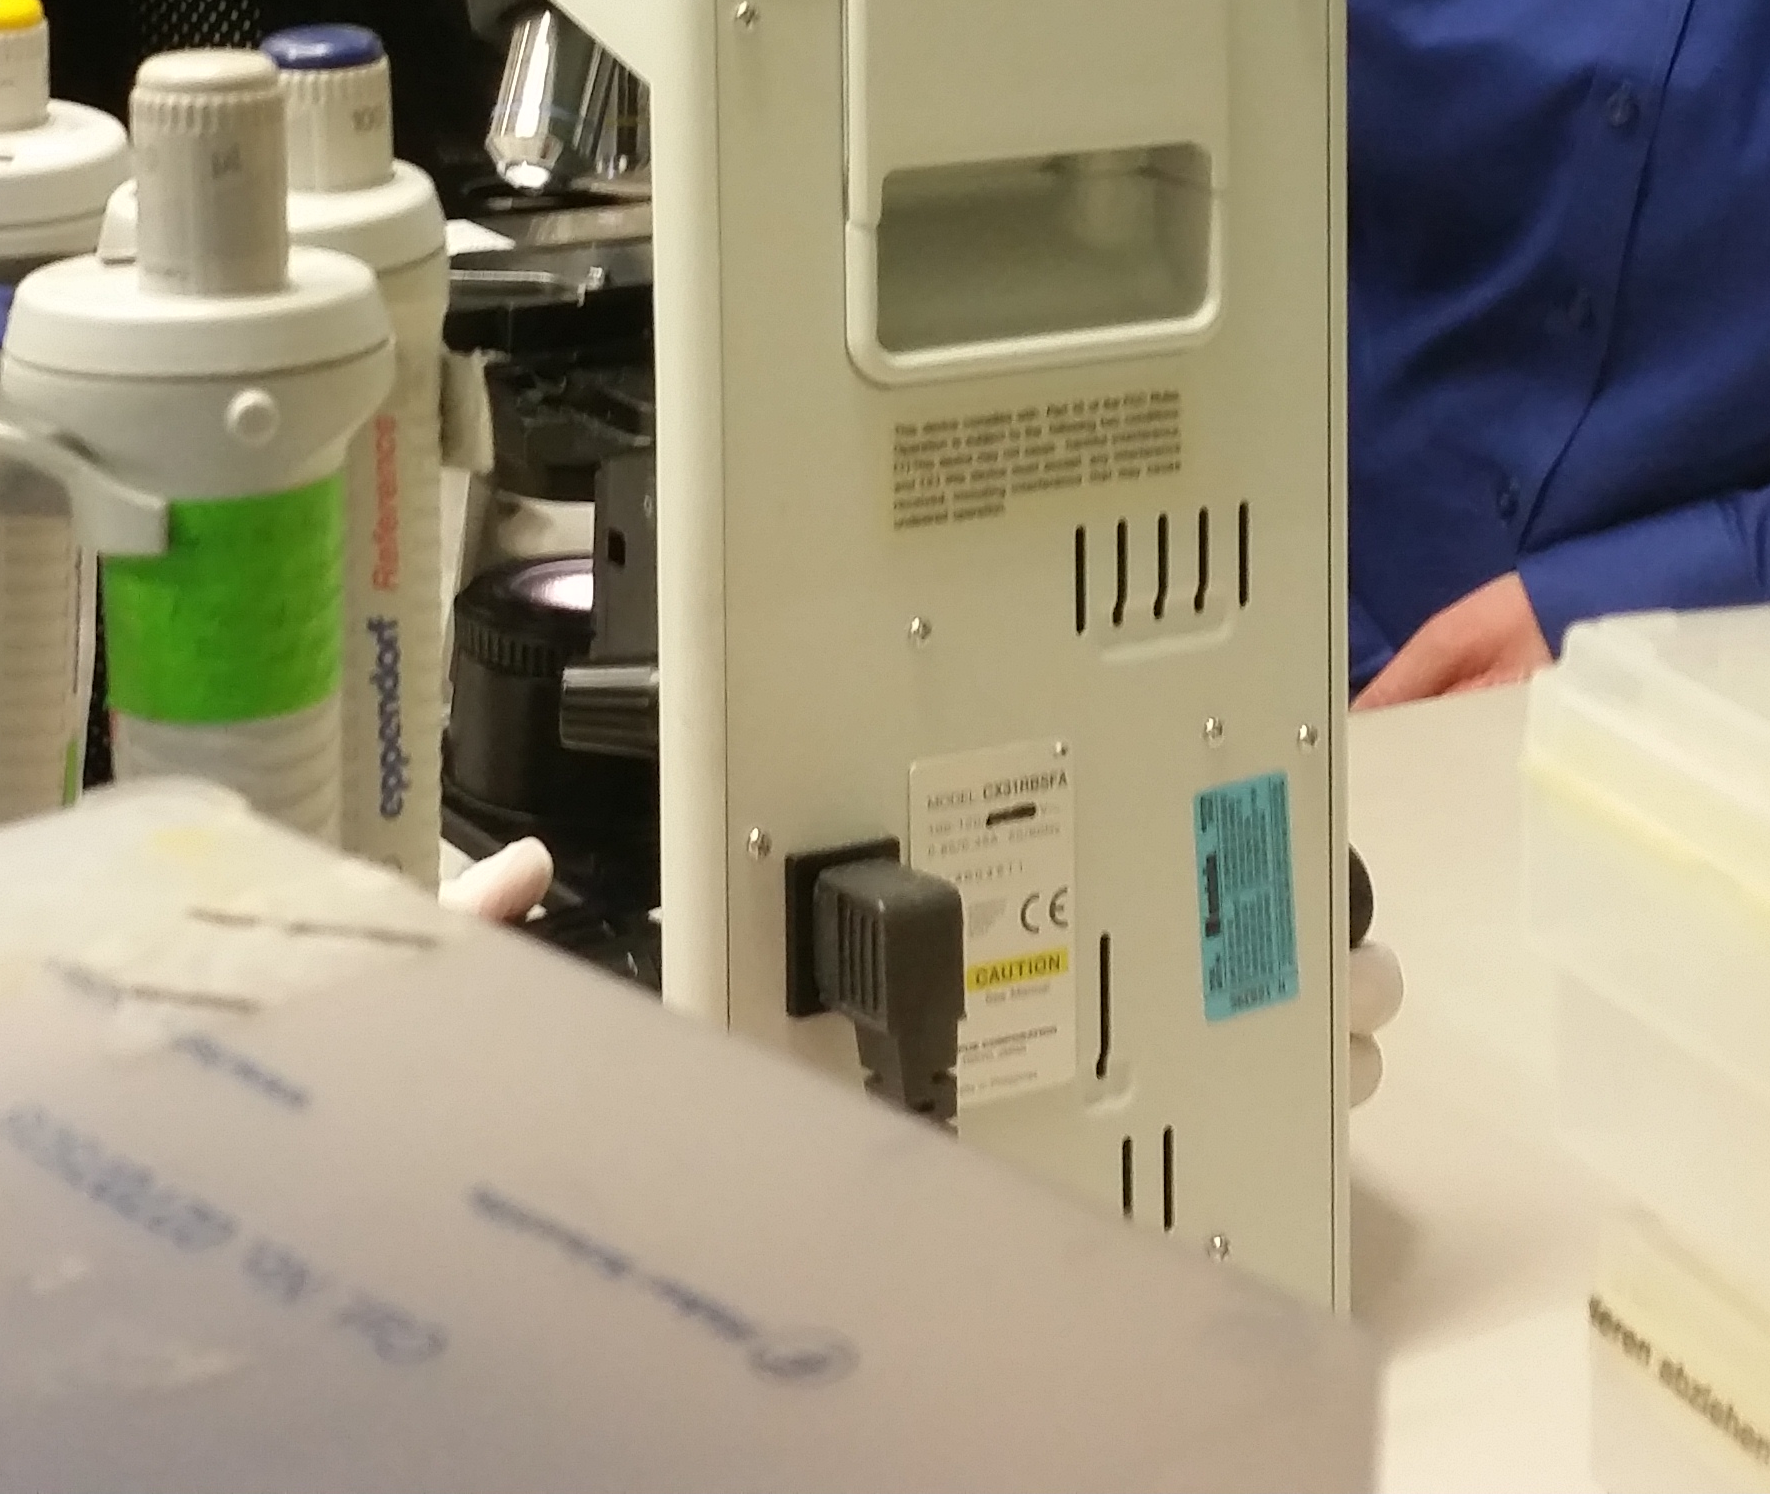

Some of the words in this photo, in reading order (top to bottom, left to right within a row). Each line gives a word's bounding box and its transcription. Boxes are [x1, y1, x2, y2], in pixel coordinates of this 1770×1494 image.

[373, 413, 400, 592] Reference
[367, 615, 411, 819] eppendorf
[975, 953, 1061, 988] CAUTION
